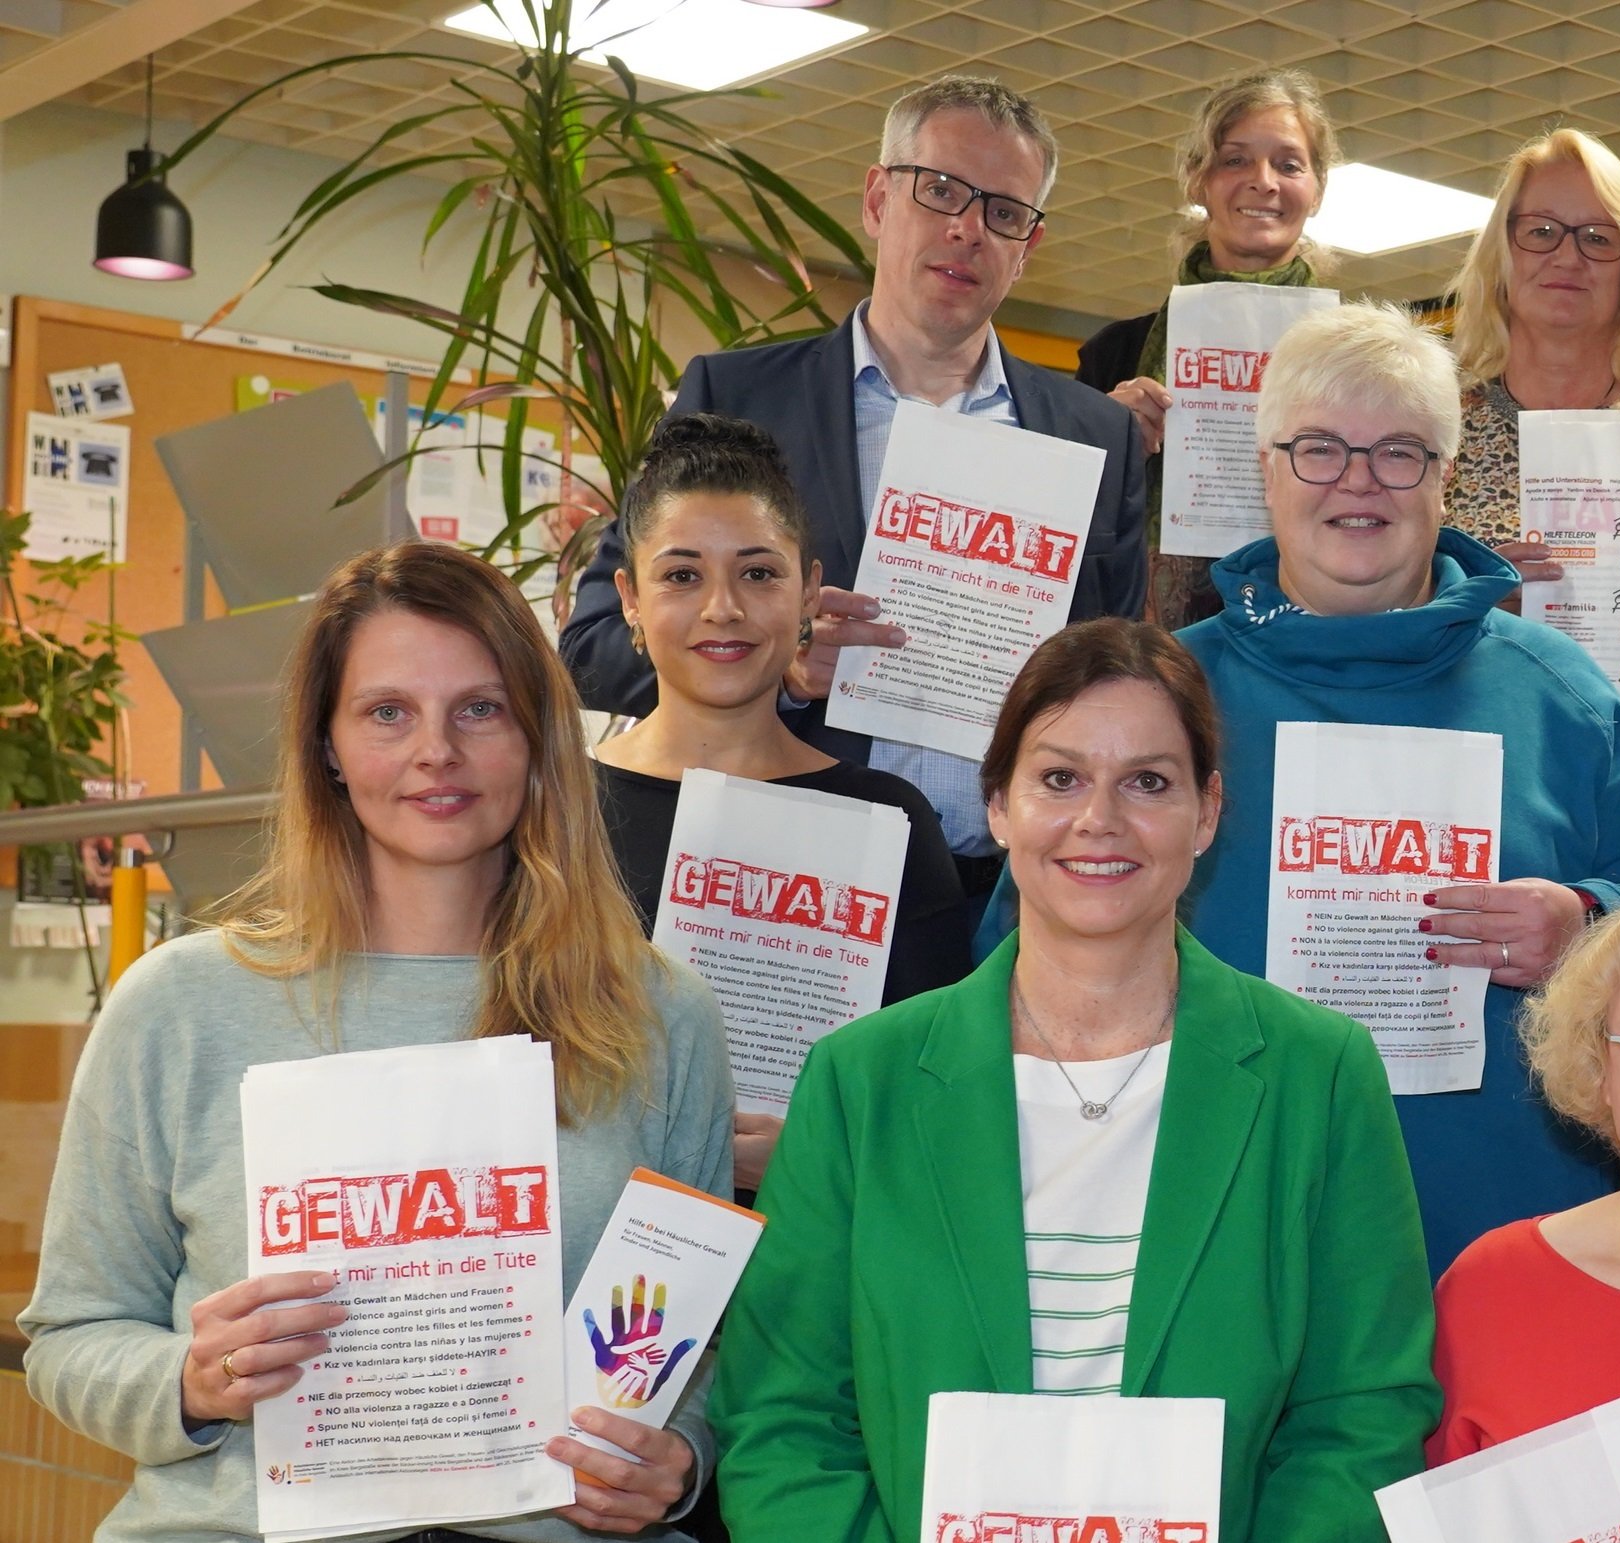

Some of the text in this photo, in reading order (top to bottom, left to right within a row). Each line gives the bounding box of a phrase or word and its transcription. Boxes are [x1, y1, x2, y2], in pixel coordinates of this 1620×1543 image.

[1174, 348, 1270, 393] GEW
[1180, 397, 1258, 413] kommt mir nic
[874, 487, 1078, 584] GEWALT
[876, 550, 1054, 603] kommt mir nicht in die Tüte
[1279, 816, 1494, 882] GEWALT
[670, 853, 890, 946] GEWALT
[1287, 885, 1418, 902] kommt mir nicht in
[674, 916, 869, 967] kommt mir nicht in die Tüte
[259, 1165, 551, 1257] GEWALT
[628, 1217, 727, 1258] Hilfe bei Häuslicher Gewalt
[347, 1264, 377, 1282] mir
[384, 1259, 430, 1279] nicht
[437, 1258, 453, 1276] in
[459, 1255, 486, 1273] die
[493, 1251, 536, 1269] Tüte
[328, 1315, 523, 1338] la violence contre les filles et les femmes
[323, 1360, 340, 1369] Kız
[355, 1357, 400, 1367] kadınlara
[402, 1355, 426, 1364] karşı
[307, 1392, 325, 1402] NIE
[327, 1391, 343, 1400] dla
[344, 1389, 392, 1401] przemocy
[393, 1386, 426, 1395] wobec
[427, 1383, 458, 1393] kobiet
[459, 1383, 463, 1391] i
[325, 1406, 341, 1415] NO
[342, 1405, 360, 1414] alla
[362, 1404, 402, 1413] violenza
[412, 1400, 450, 1411] ragazze
[468, 1395, 499, 1406] Donne
[316, 1422, 349, 1432] Spune
[350, 1420, 366, 1428] NU
[430, 1415, 443, 1424] de
[445, 1413, 469, 1423] copii
[481, 1408, 507, 1419] femei
[315, 1437, 335, 1447] НЕТ
[336, 1435, 381, 1445] насилию
[382, 1434, 401, 1442] над
